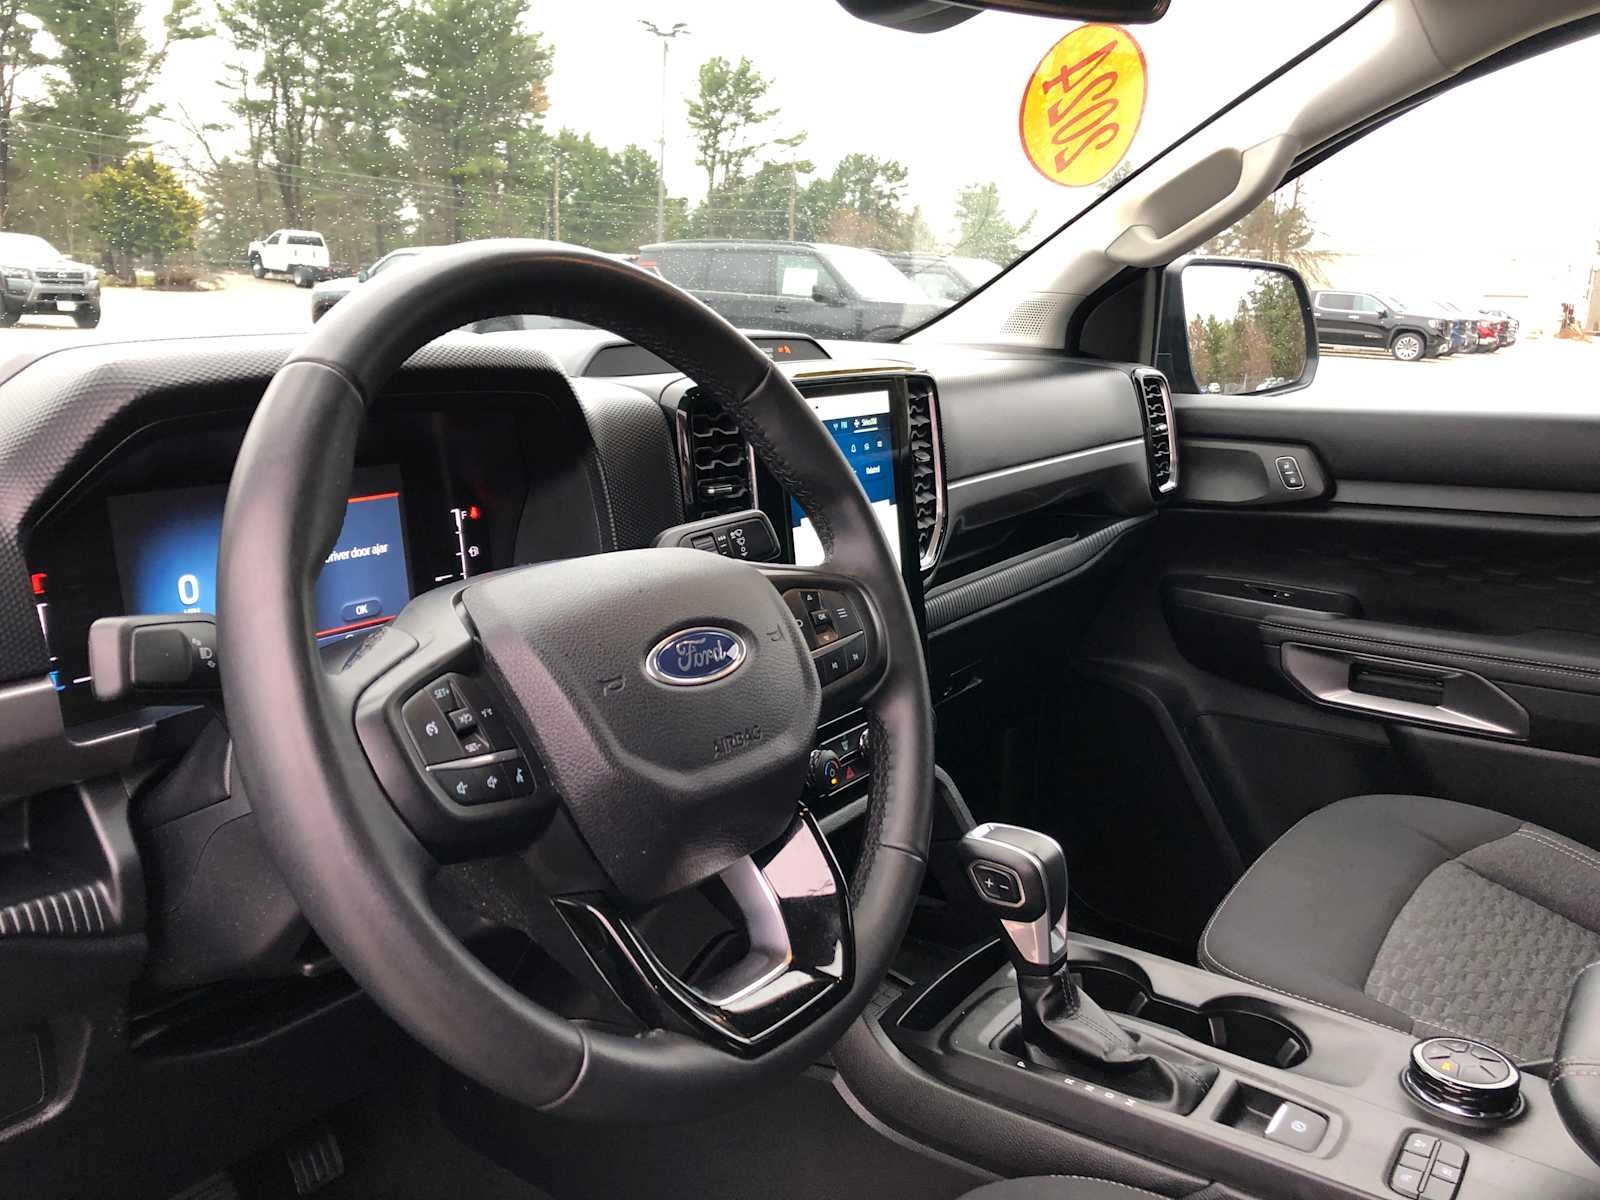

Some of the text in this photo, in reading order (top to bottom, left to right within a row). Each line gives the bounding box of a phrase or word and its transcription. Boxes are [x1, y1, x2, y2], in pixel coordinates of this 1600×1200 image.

[461, 510, 467, 520] F
[351, 546, 371, 558] door
[371, 544, 388, 556] ajar
[178, 574, 199, 605] 0
[355, 604, 368, 615] OK
[676, 638, 726, 672] Ford
[713, 726, 764, 760] AIRBAG
